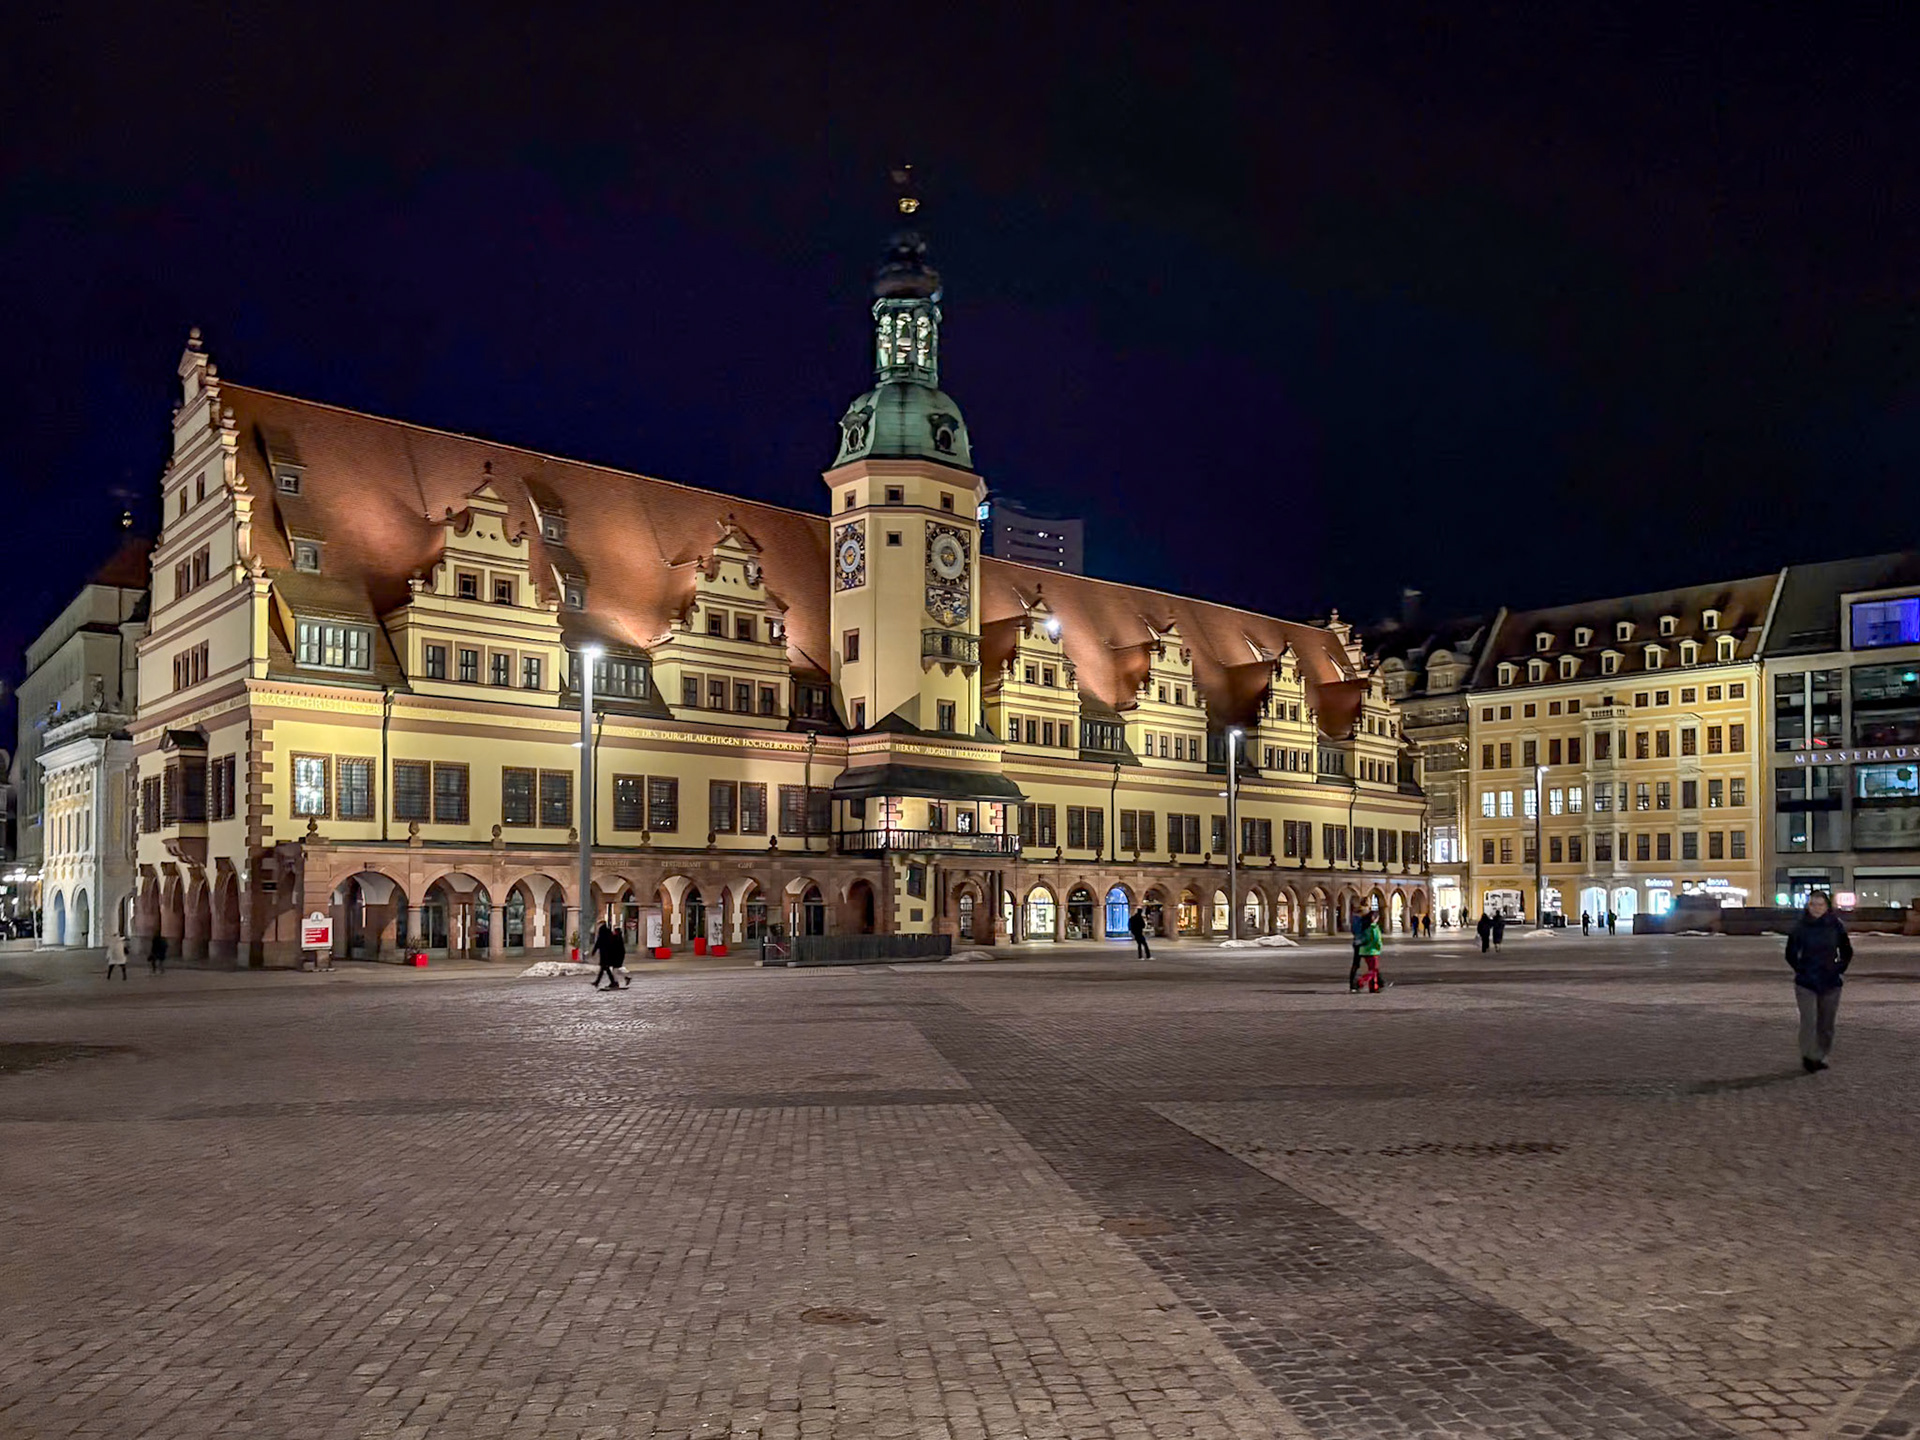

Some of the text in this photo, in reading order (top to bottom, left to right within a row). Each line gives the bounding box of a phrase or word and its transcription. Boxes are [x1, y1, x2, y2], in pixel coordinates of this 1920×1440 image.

[259, 692, 293, 706] NACH
[297, 697, 345, 711] CHRISTI
[641, 728, 657, 738] DES
[896, 744, 921, 754] HERRN
[1794, 748, 1920, 763] MESSEHAUS
